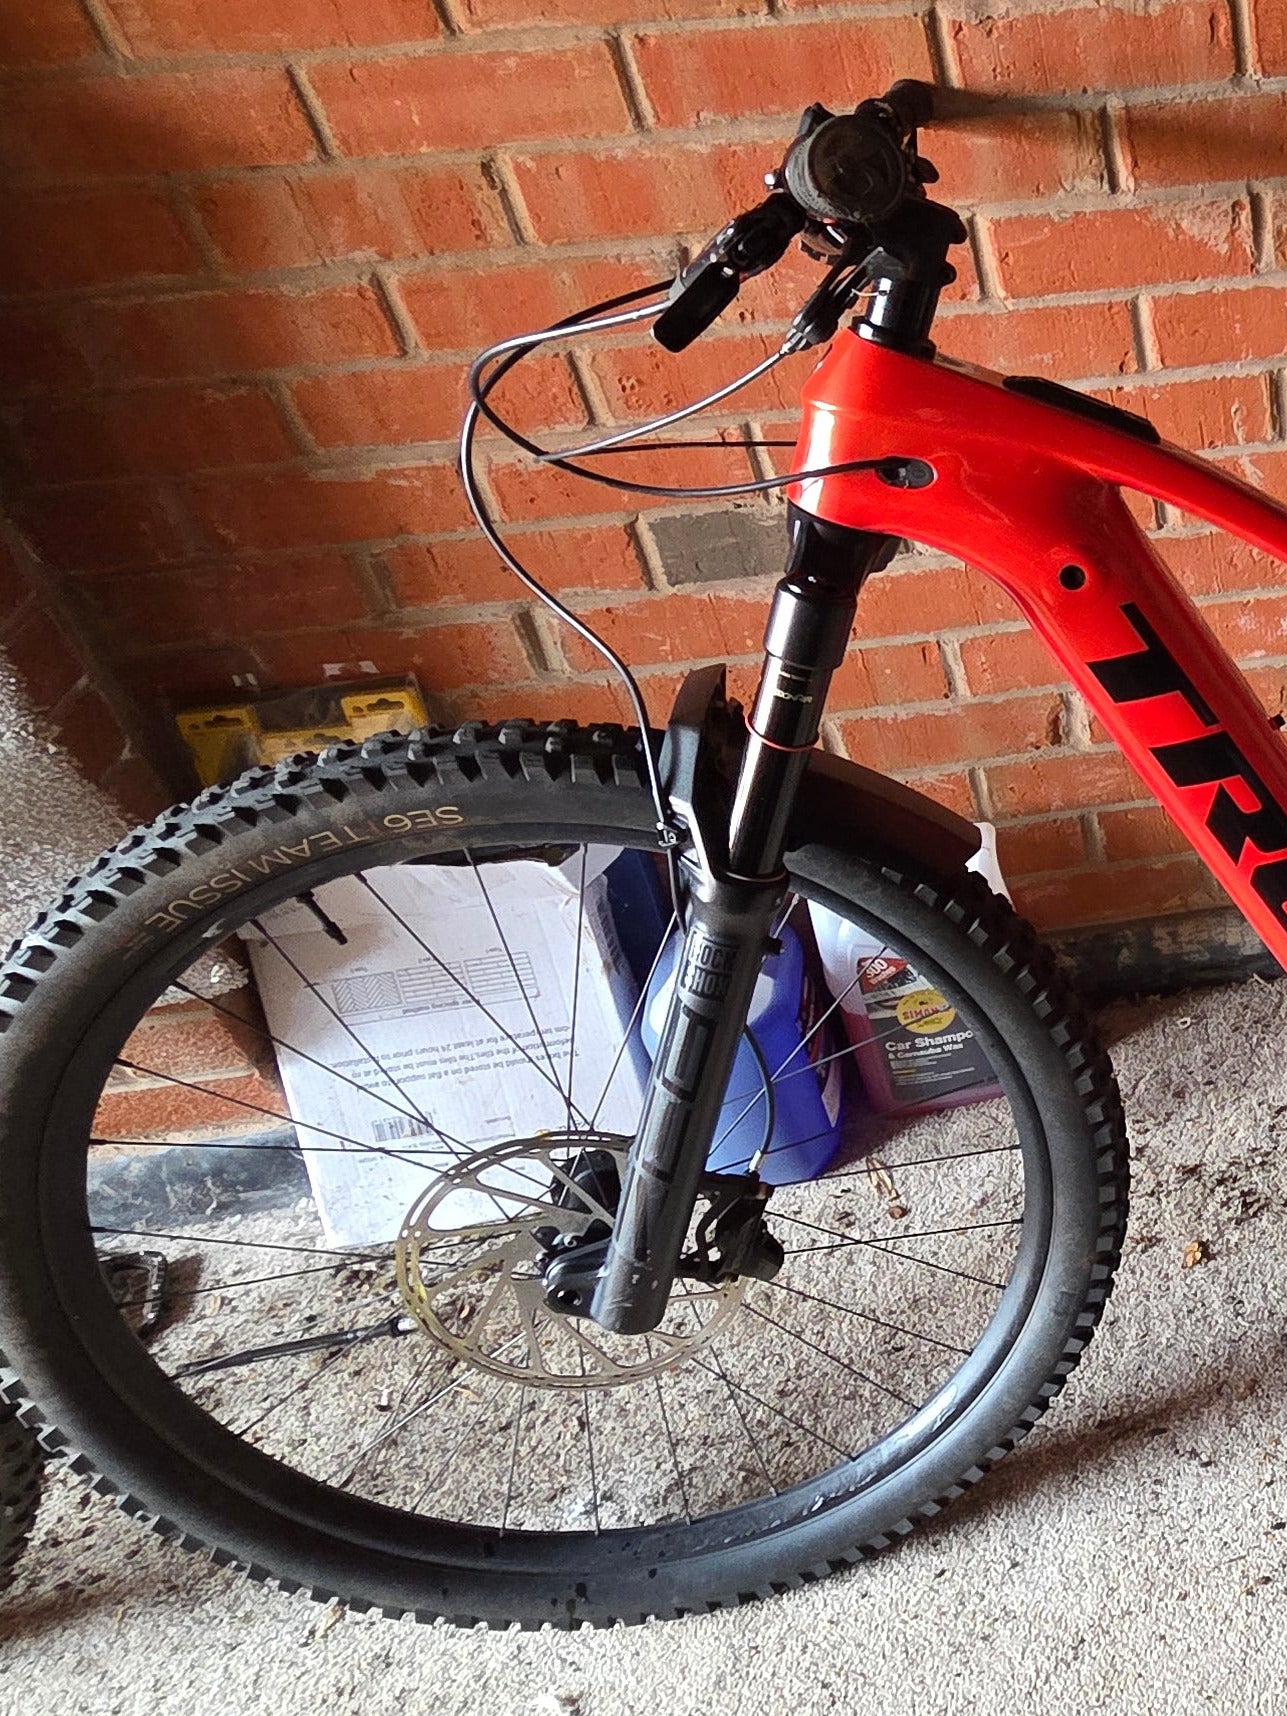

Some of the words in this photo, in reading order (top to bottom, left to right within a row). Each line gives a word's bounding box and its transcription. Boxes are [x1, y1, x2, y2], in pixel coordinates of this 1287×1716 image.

[383, 805, 465, 833] SE6
[250, 824, 371, 875] TEAM
[144, 868, 251, 933] ISSUE
[884, 1040, 912, 1052] Car
[913, 1029, 974, 1049] Shampo
[535, 1051, 562, 1061] boes
[392, 1073, 427, 1086] suppor
[463, 1062, 491, 1074] stored
